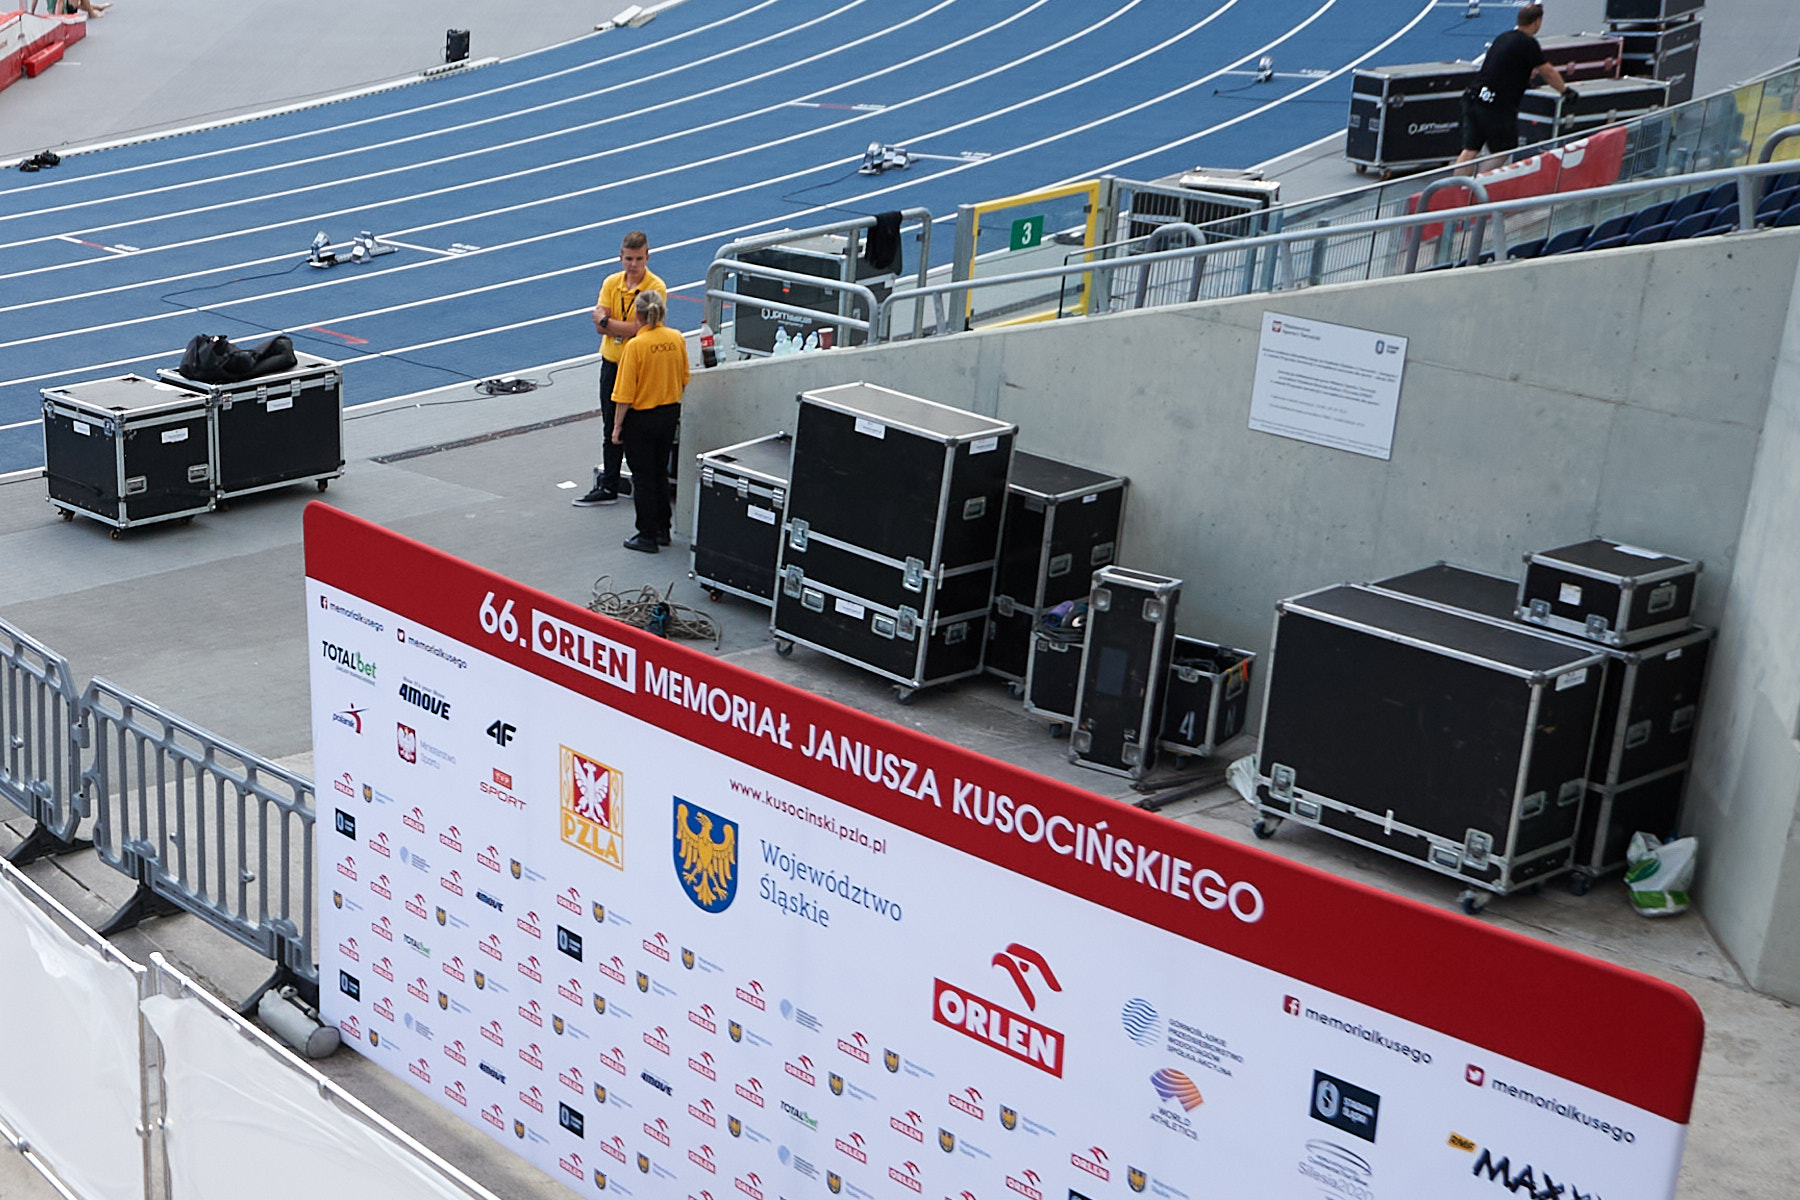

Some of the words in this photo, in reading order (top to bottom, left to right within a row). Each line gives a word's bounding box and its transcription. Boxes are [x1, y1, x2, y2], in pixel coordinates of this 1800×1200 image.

[1021, 221, 1033, 245] 3
[322, 640, 377, 679] TOTALbet
[486, 720, 517, 747] 4F
[1179, 711, 1195, 741] 4
[479, 591, 527, 648] 66.
[538, 620, 628, 683] ORLEN
[645, 661, 792, 750] MEMORIAŁ
[800, 724, 942, 808] JANUSZA
[952, 778, 1265, 924] KUSOCIŃSKIEGO
[480, 781, 527, 810] SPORT
[729, 778, 887, 854] www.kusocinski.pzla.pl
[563, 813, 620, 864] PZLA
[760, 838, 902, 921] Województwo
[759, 873, 830, 928] Śląskie
[938, 989, 1057, 1070] ORLEN
[1305, 1007, 1432, 1064] memorialkusego
[950, 1096, 982, 1118] ORLEN
[1158, 1106, 1192, 1126] WORLD
[1491, 1078, 1636, 1143] memorialkusego
[892, 1119, 922, 1141] ORLEN
[890, 1170, 920, 1192] ORLEN
[1073, 1155, 1109, 1180] ORLEN
